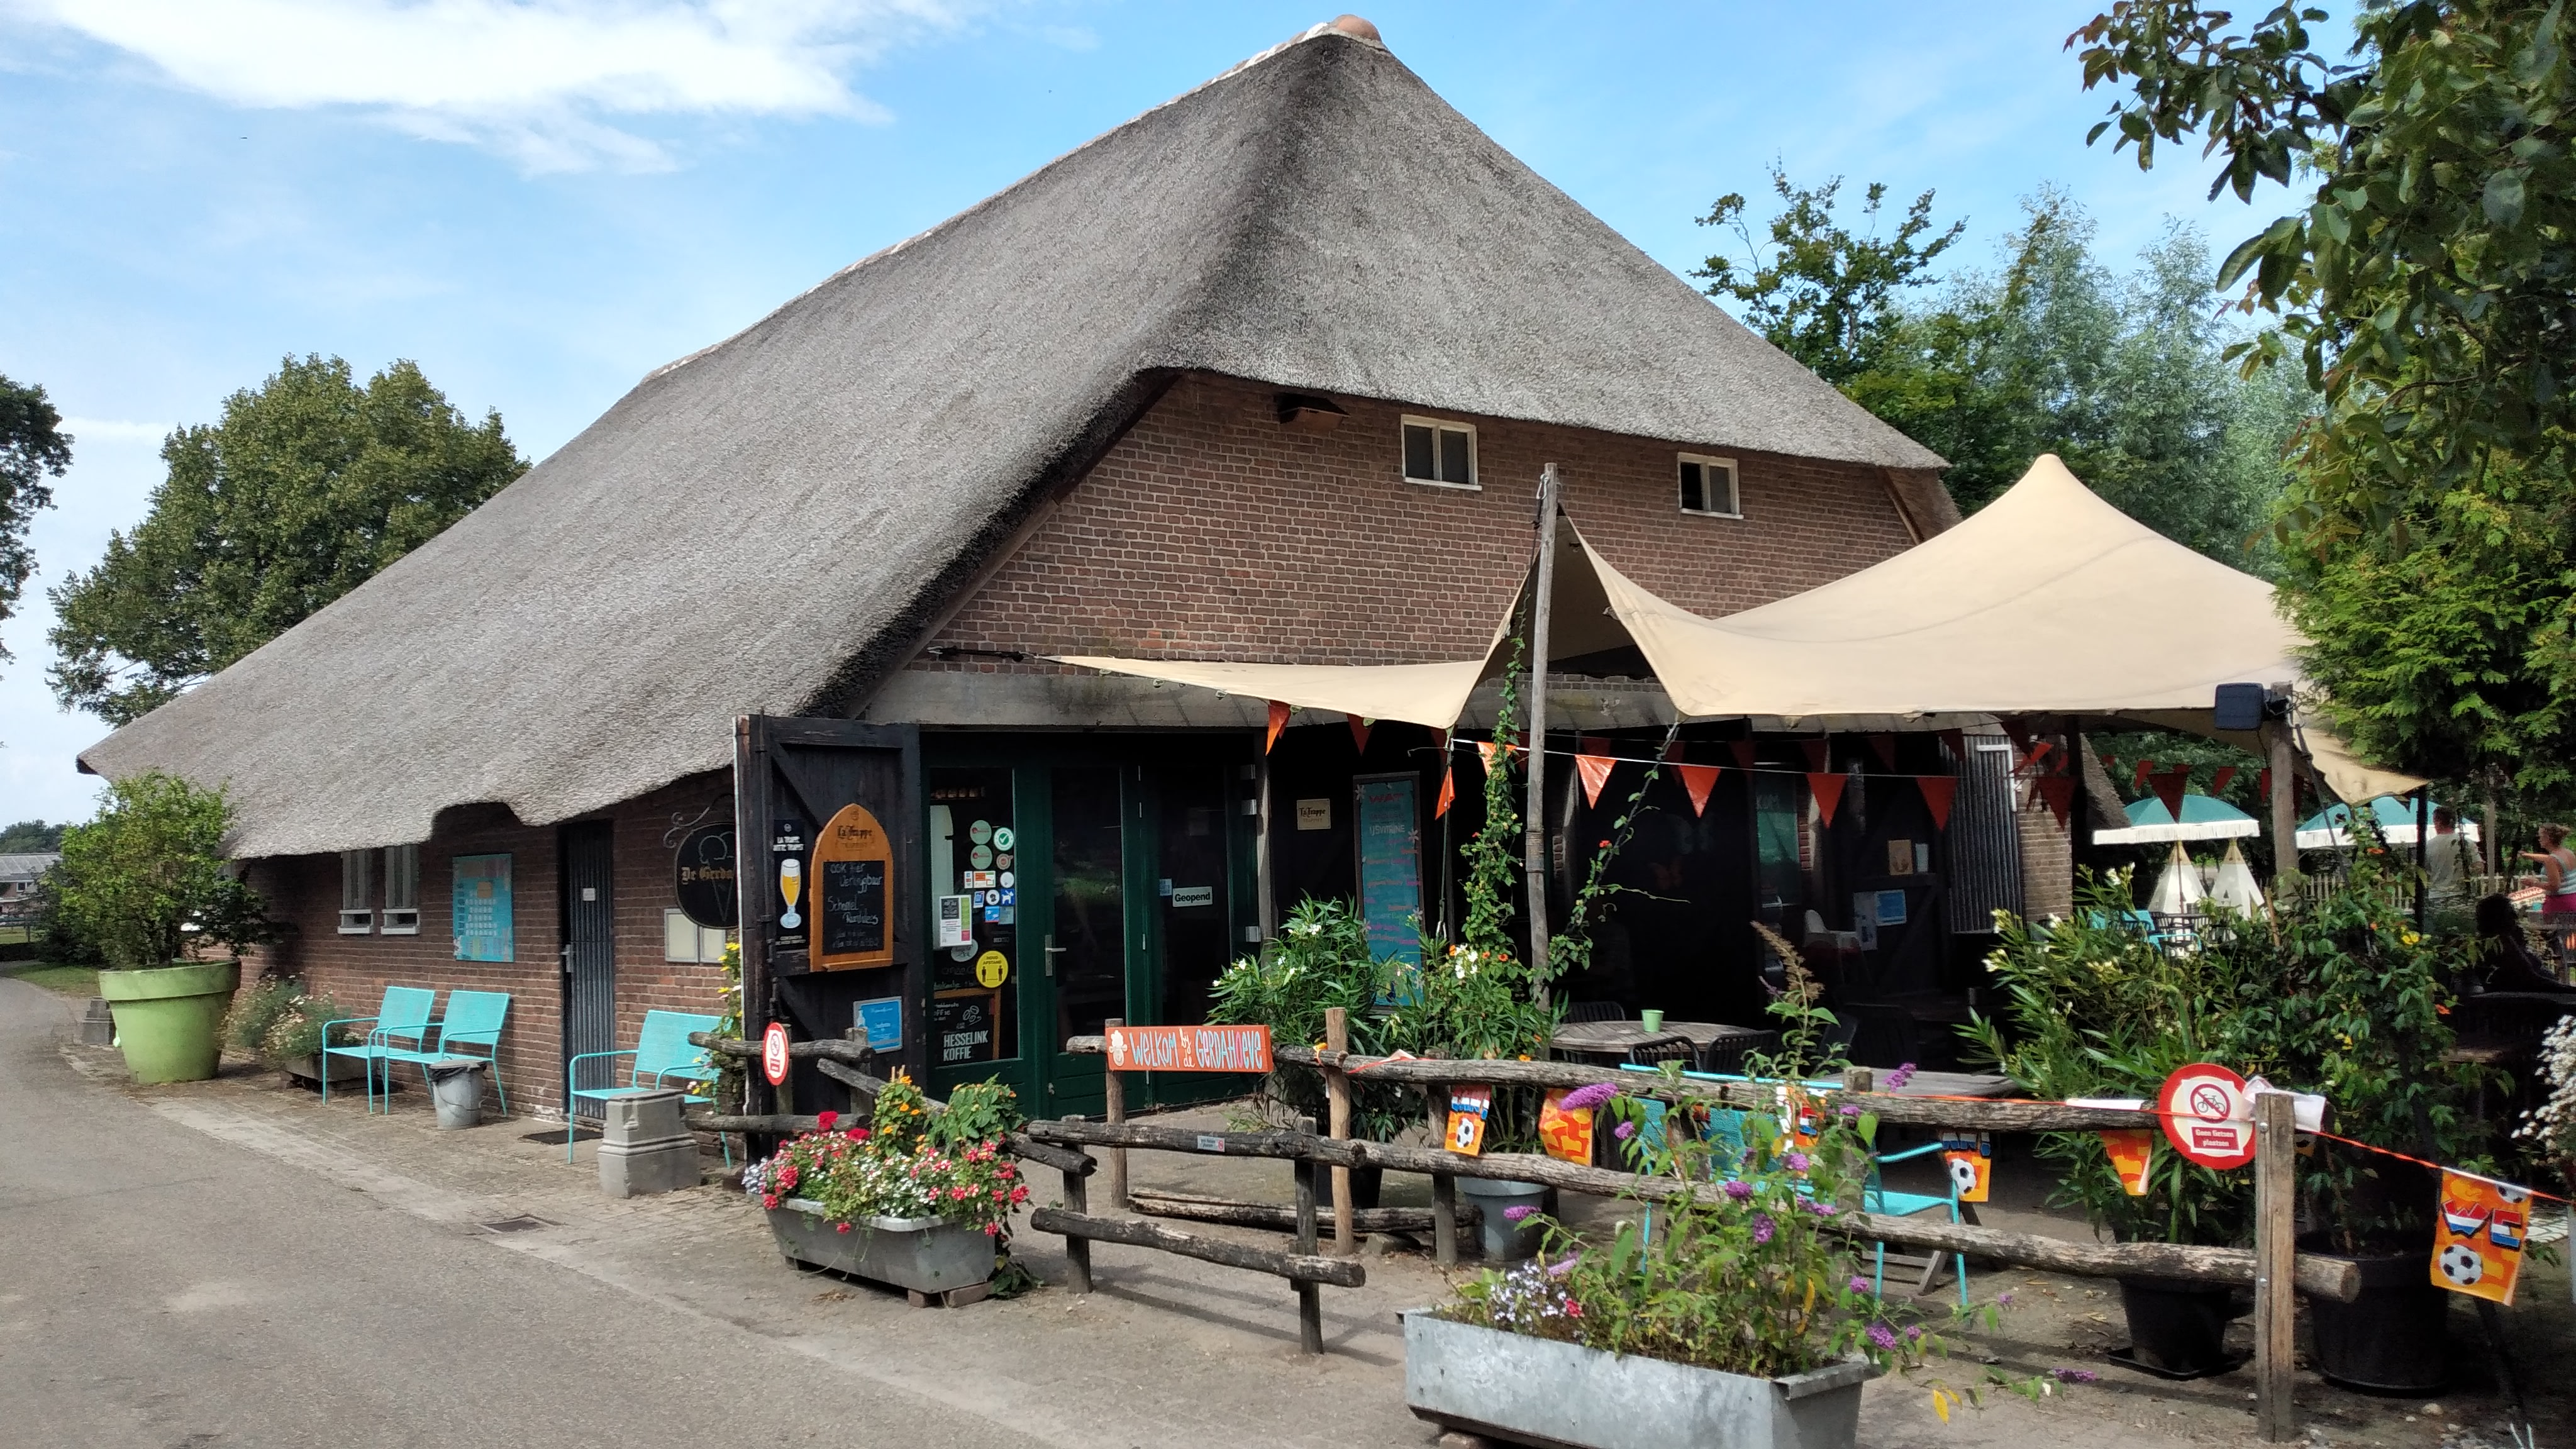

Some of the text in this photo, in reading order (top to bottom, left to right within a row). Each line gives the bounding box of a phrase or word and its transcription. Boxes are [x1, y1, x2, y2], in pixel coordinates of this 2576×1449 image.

[1306, 807, 1326, 818] Trappe
[1175, 892, 1211, 903] Geopend
[943, 1030, 989, 1048] HESSELINK
[943, 1045, 972, 1062] KOFFIE
